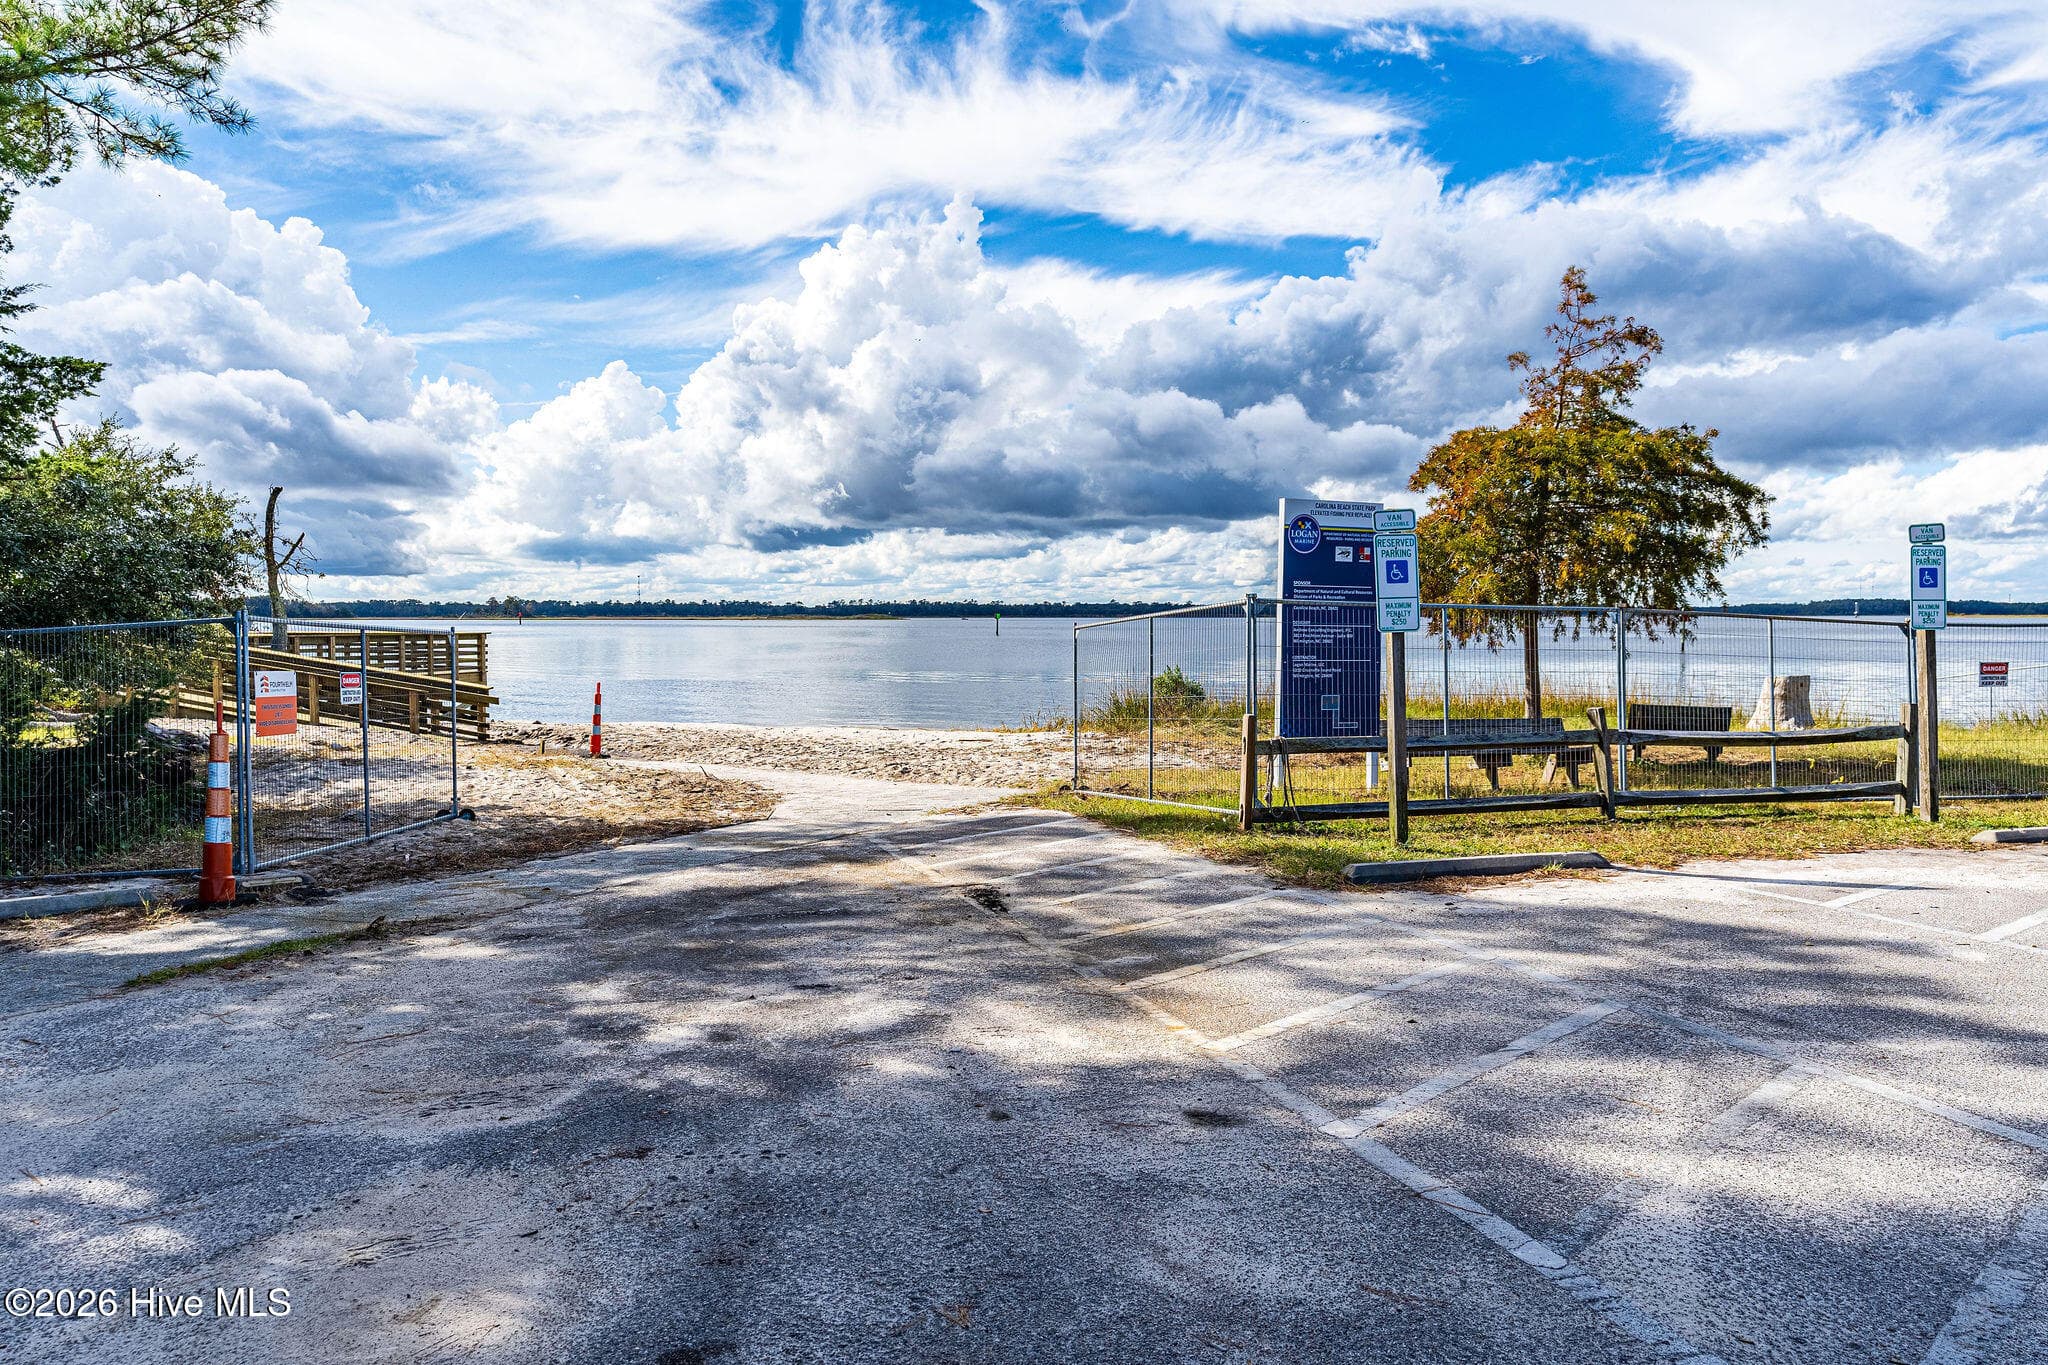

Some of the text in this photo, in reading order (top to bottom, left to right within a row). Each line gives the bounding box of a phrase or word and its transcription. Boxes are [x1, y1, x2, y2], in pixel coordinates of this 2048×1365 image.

[1315, 502, 1336, 510] CAROLINA
[1291, 529, 1318, 538] LOGAN
[1377, 538, 1414, 548] RESERVED
[1381, 549, 1411, 558] PARKING
[1913, 549, 1943, 557] RESERVED
[1916, 558, 1942, 566] PARKING
[1386, 609, 1411, 618] PENALTY
[1392, 617, 1407, 626] $250
